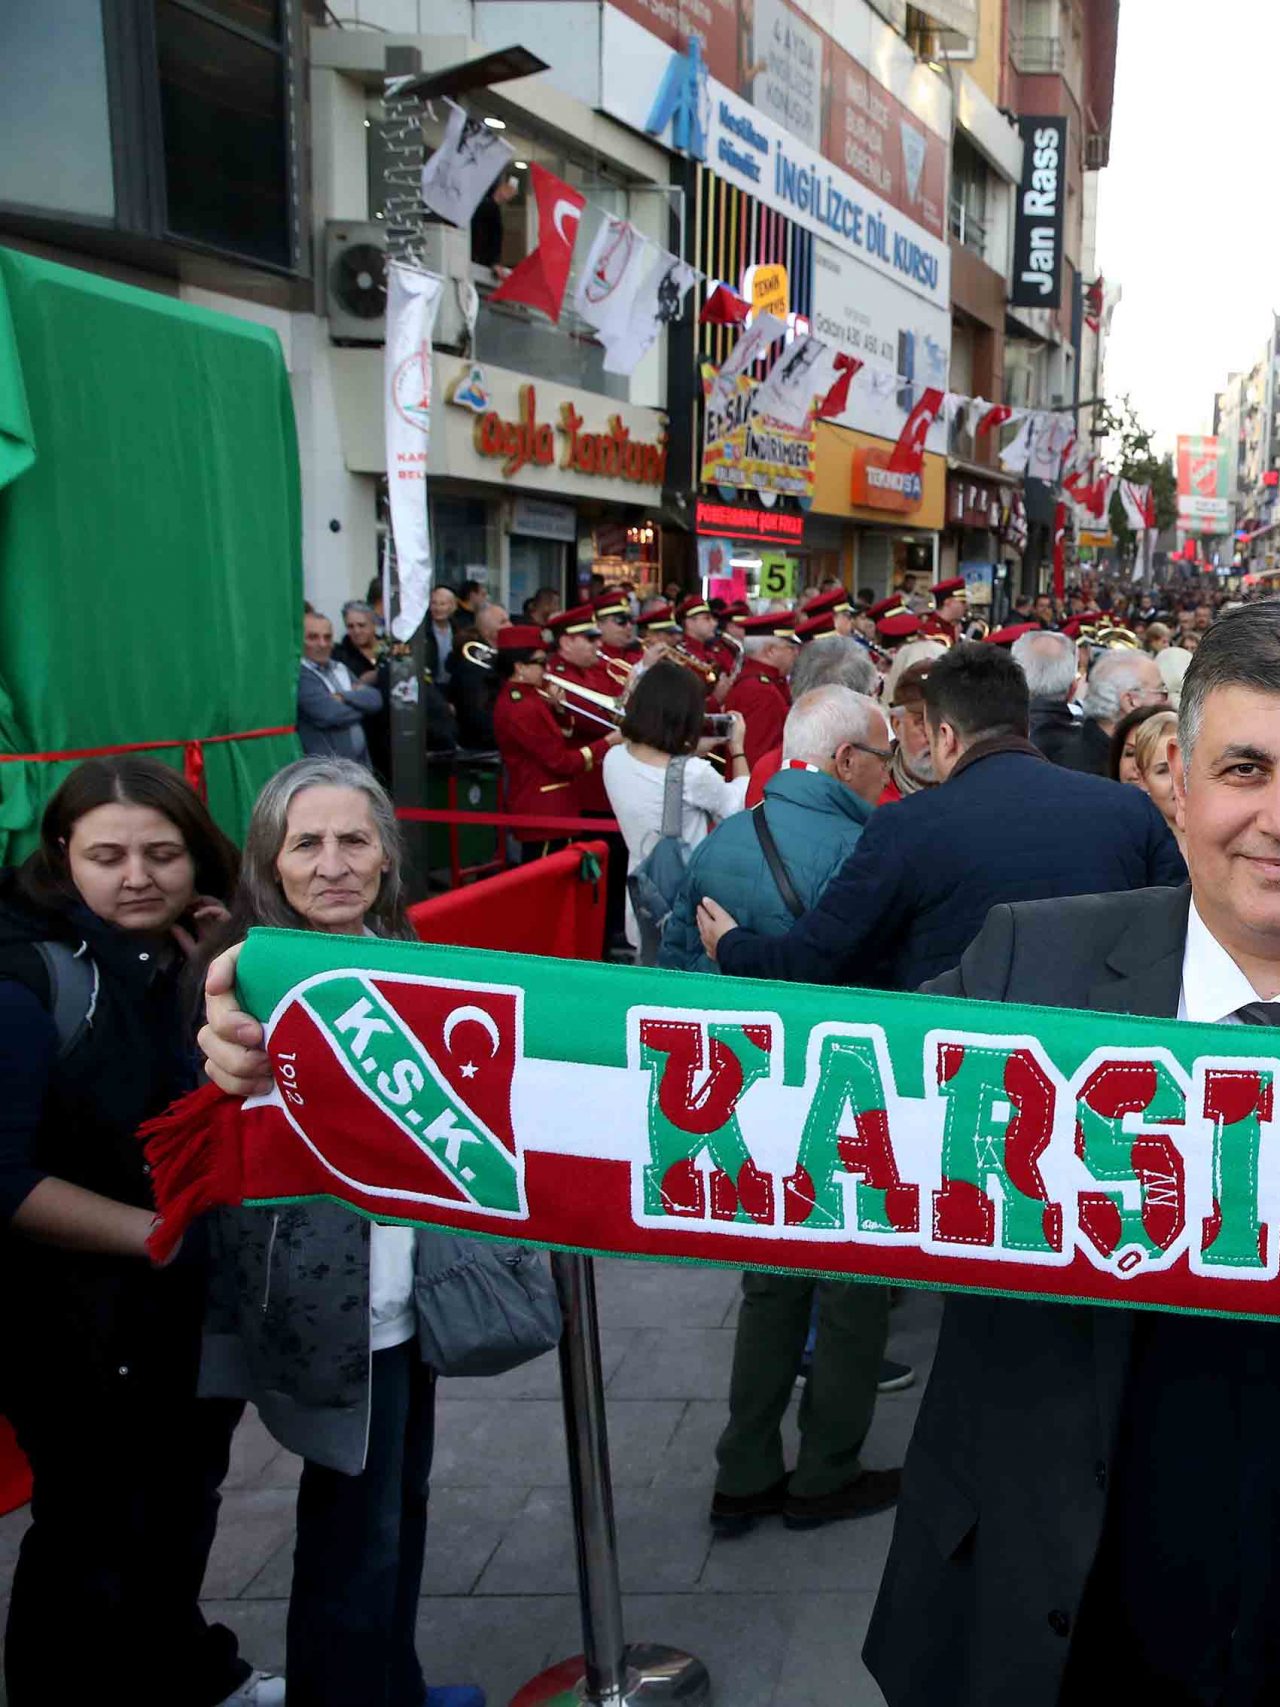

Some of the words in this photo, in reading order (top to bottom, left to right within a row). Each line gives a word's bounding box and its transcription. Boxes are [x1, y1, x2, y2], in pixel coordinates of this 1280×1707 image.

[1023, 127, 1059, 216] Rass
[775, 140, 863, 246] İNGİLİZCE
[866, 212, 890, 263] DİL
[892, 230, 939, 290] KURSU
[1021, 227, 1056, 296] Jan
[767, 564, 785, 592] 5
[277, 1051, 306, 1105] 1912
[334, 995, 484, 1181] K.S.K.
